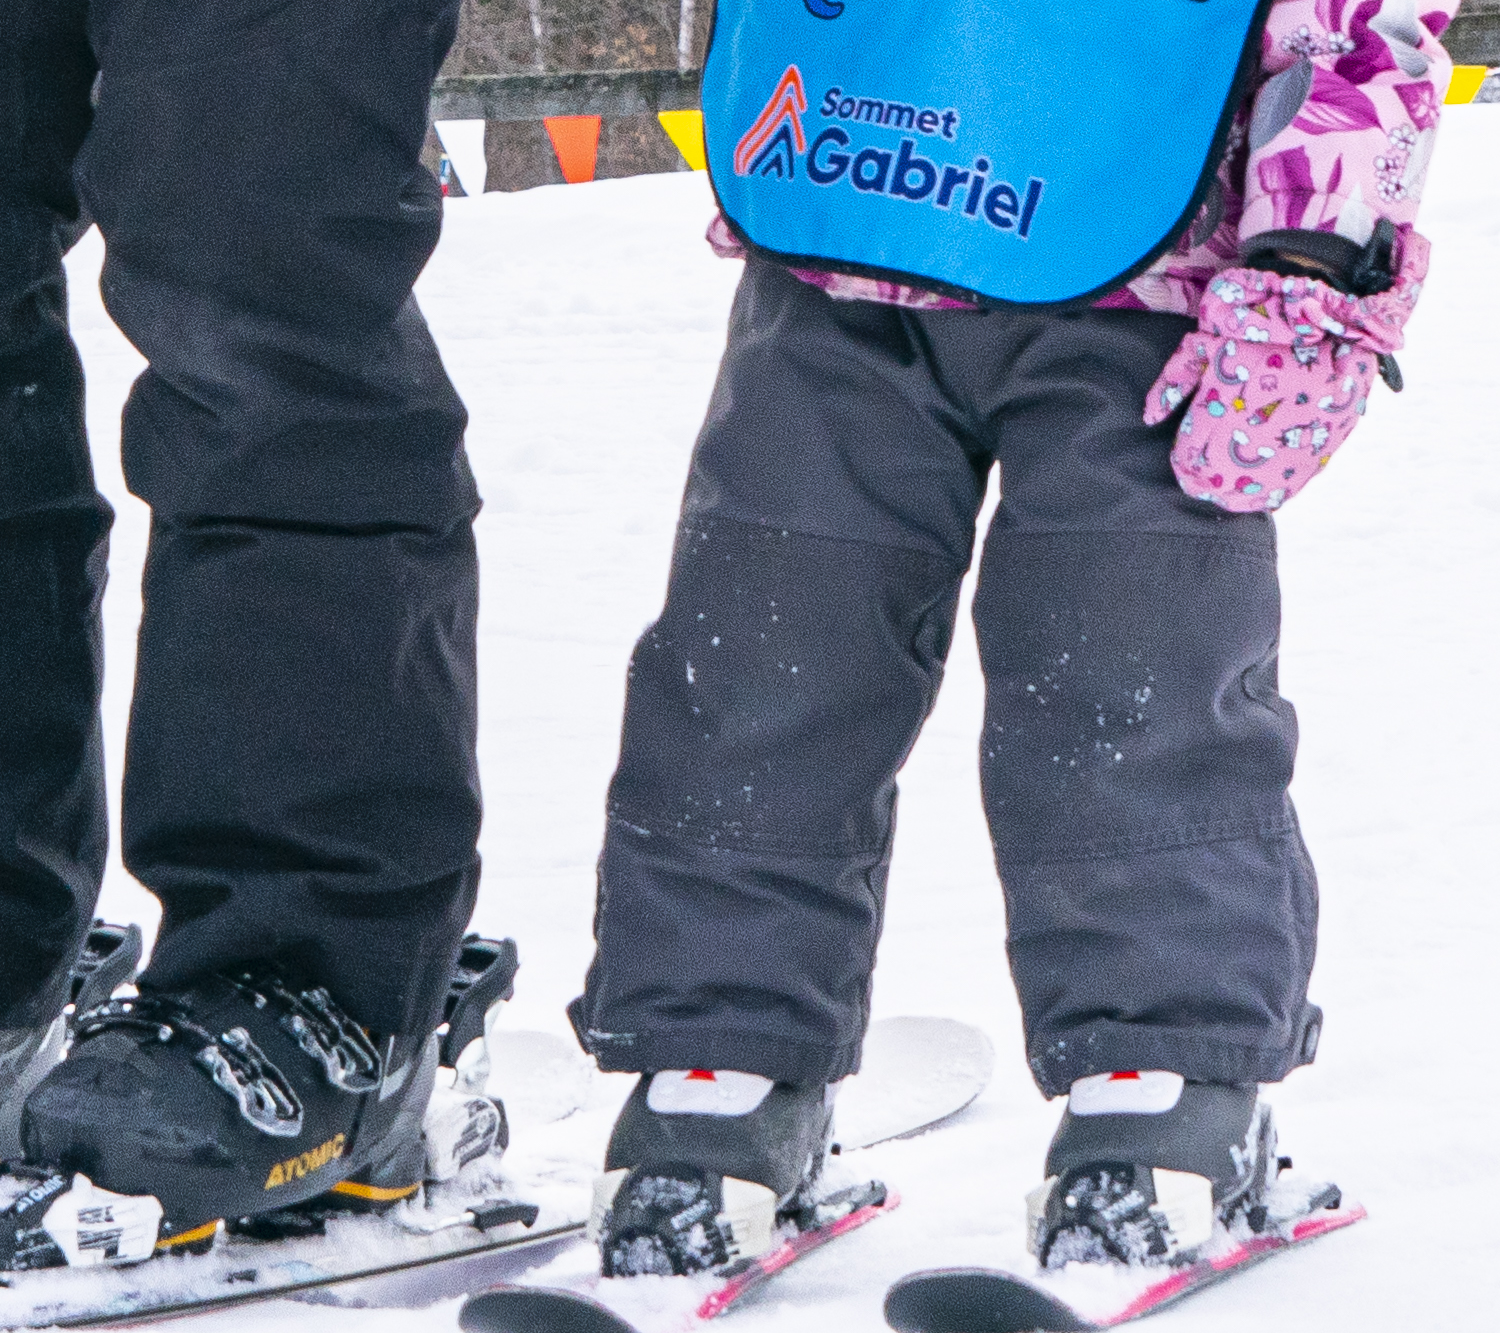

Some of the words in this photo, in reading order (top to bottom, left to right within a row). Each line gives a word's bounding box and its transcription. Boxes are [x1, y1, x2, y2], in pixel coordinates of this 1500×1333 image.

[820, 86, 958, 138] Sommet
[806, 127, 1044, 238] Gabriel
[264, 1132, 346, 1190] ATOMIC
